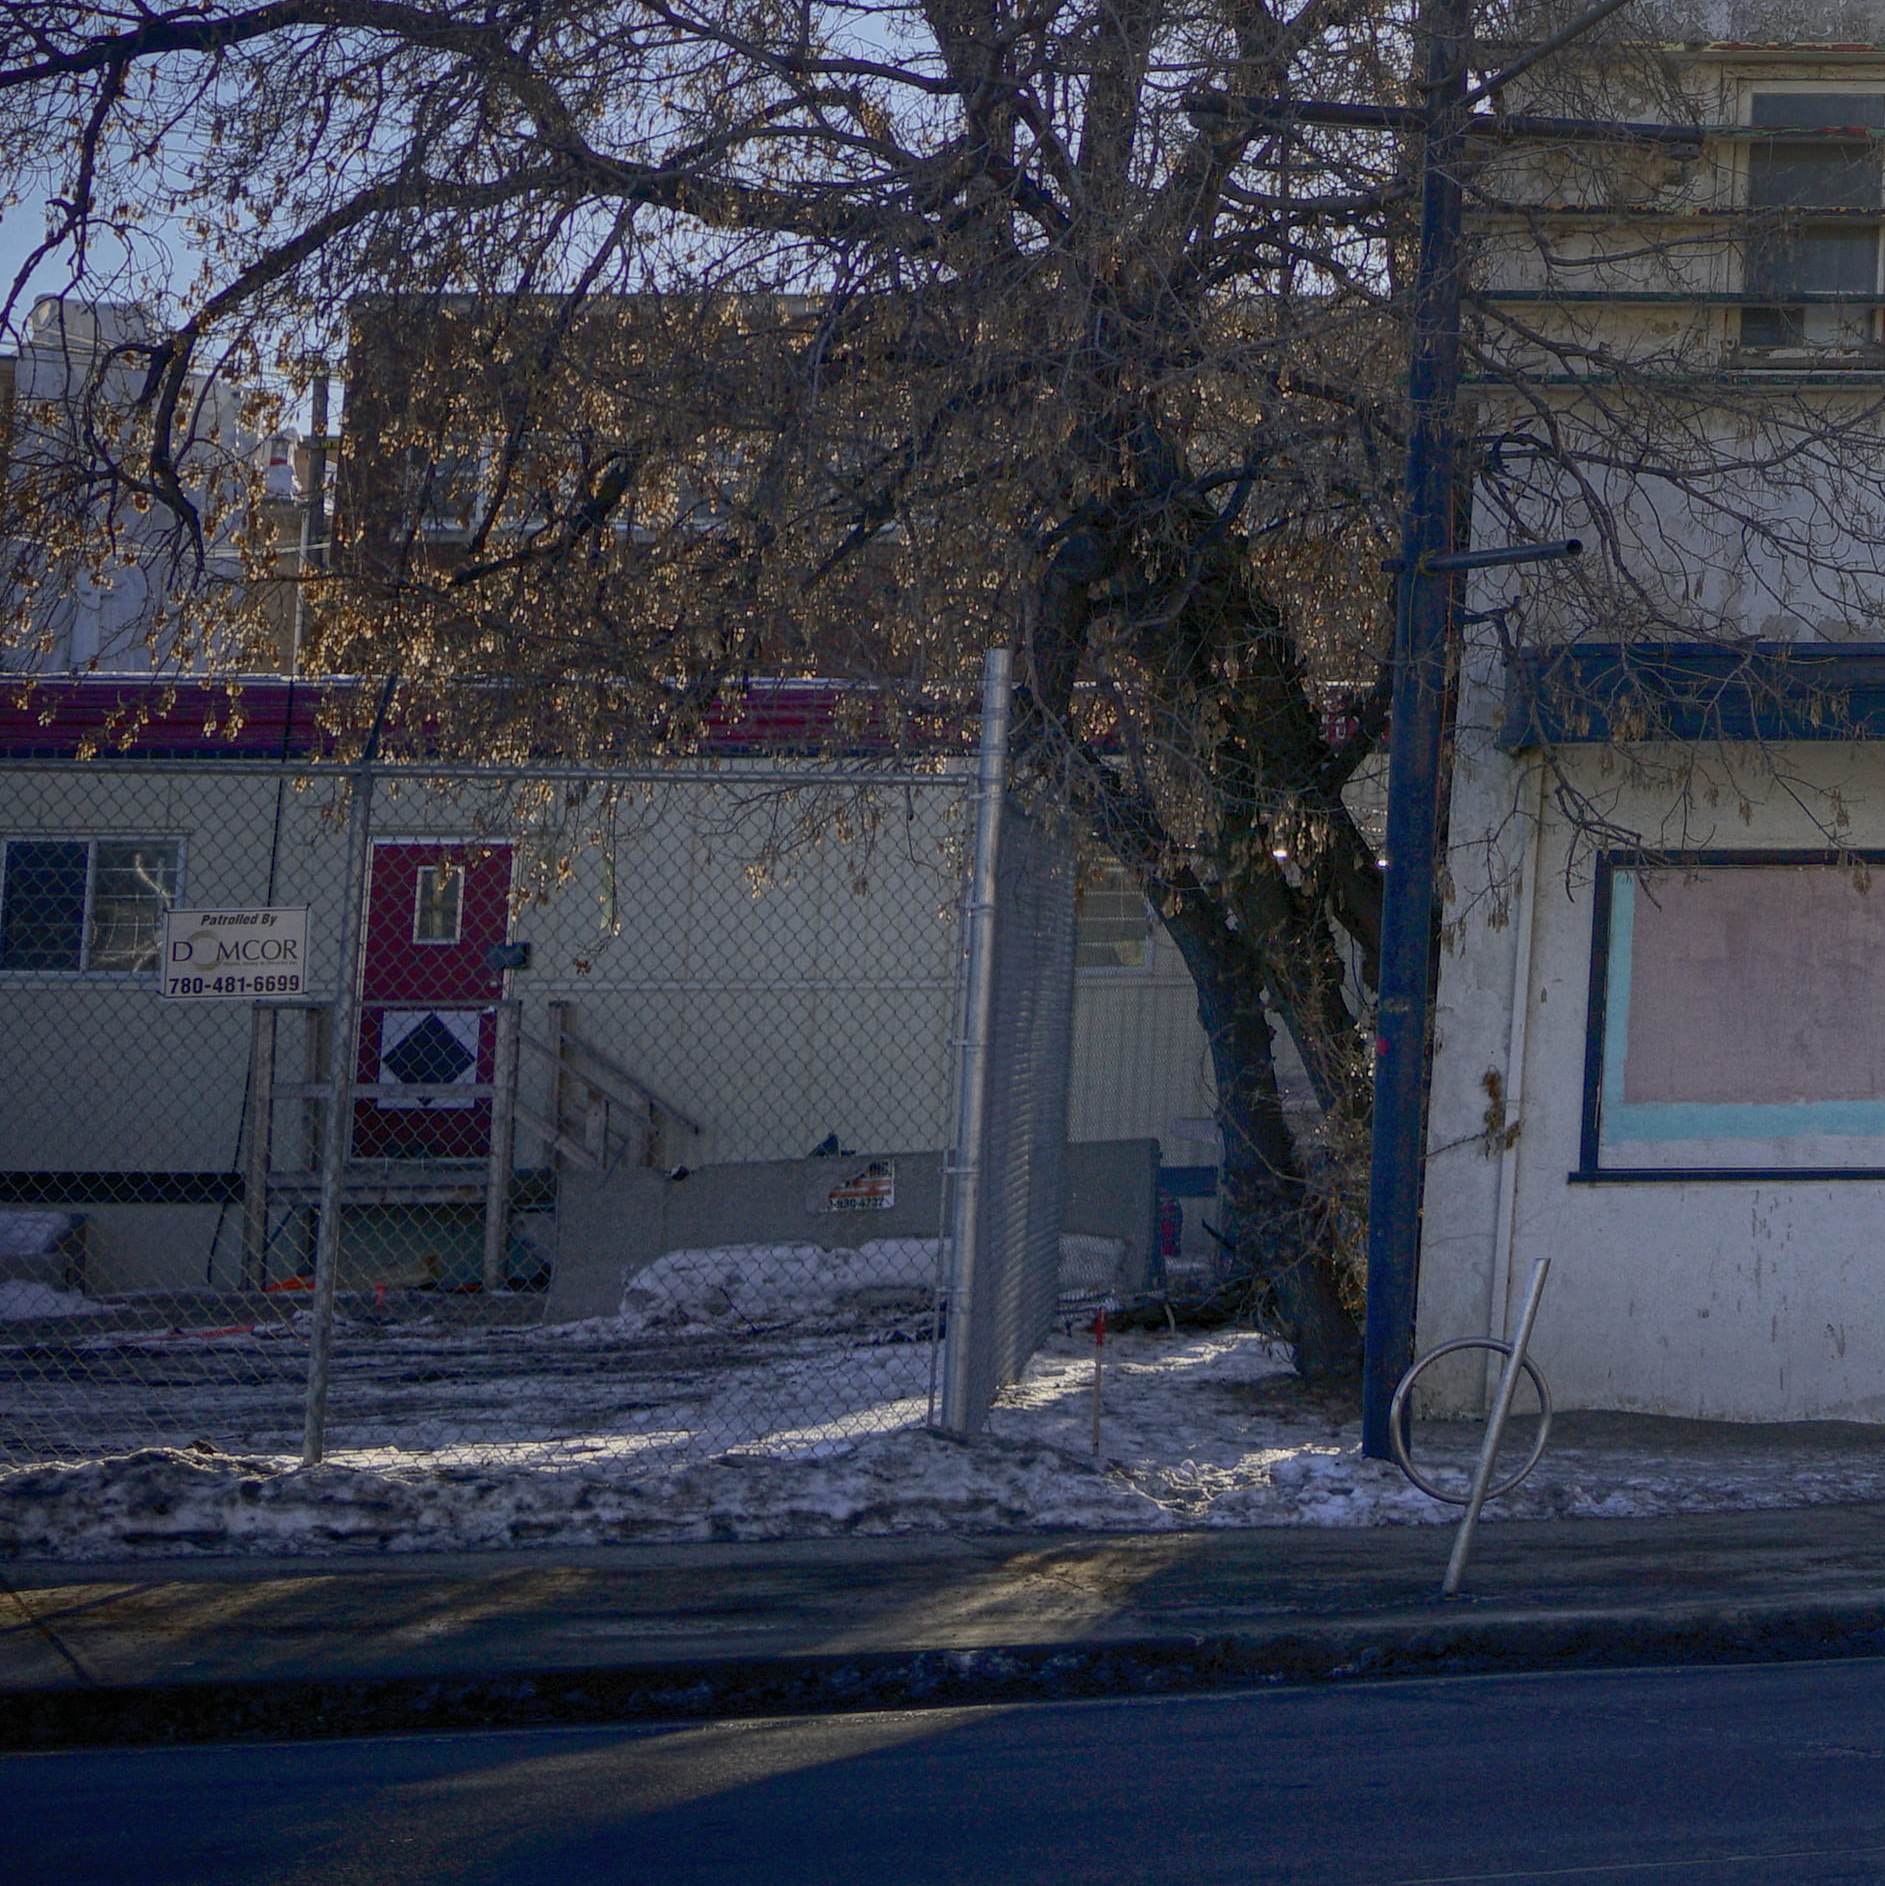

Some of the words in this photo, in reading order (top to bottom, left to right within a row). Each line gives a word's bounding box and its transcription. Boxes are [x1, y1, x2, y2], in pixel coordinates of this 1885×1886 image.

[201, 914, 257, 926] Patrolled
[260, 914, 278, 927] By
[171, 935, 298, 967] DOMCOR
[168, 975, 299, 994] 780-481-6699
